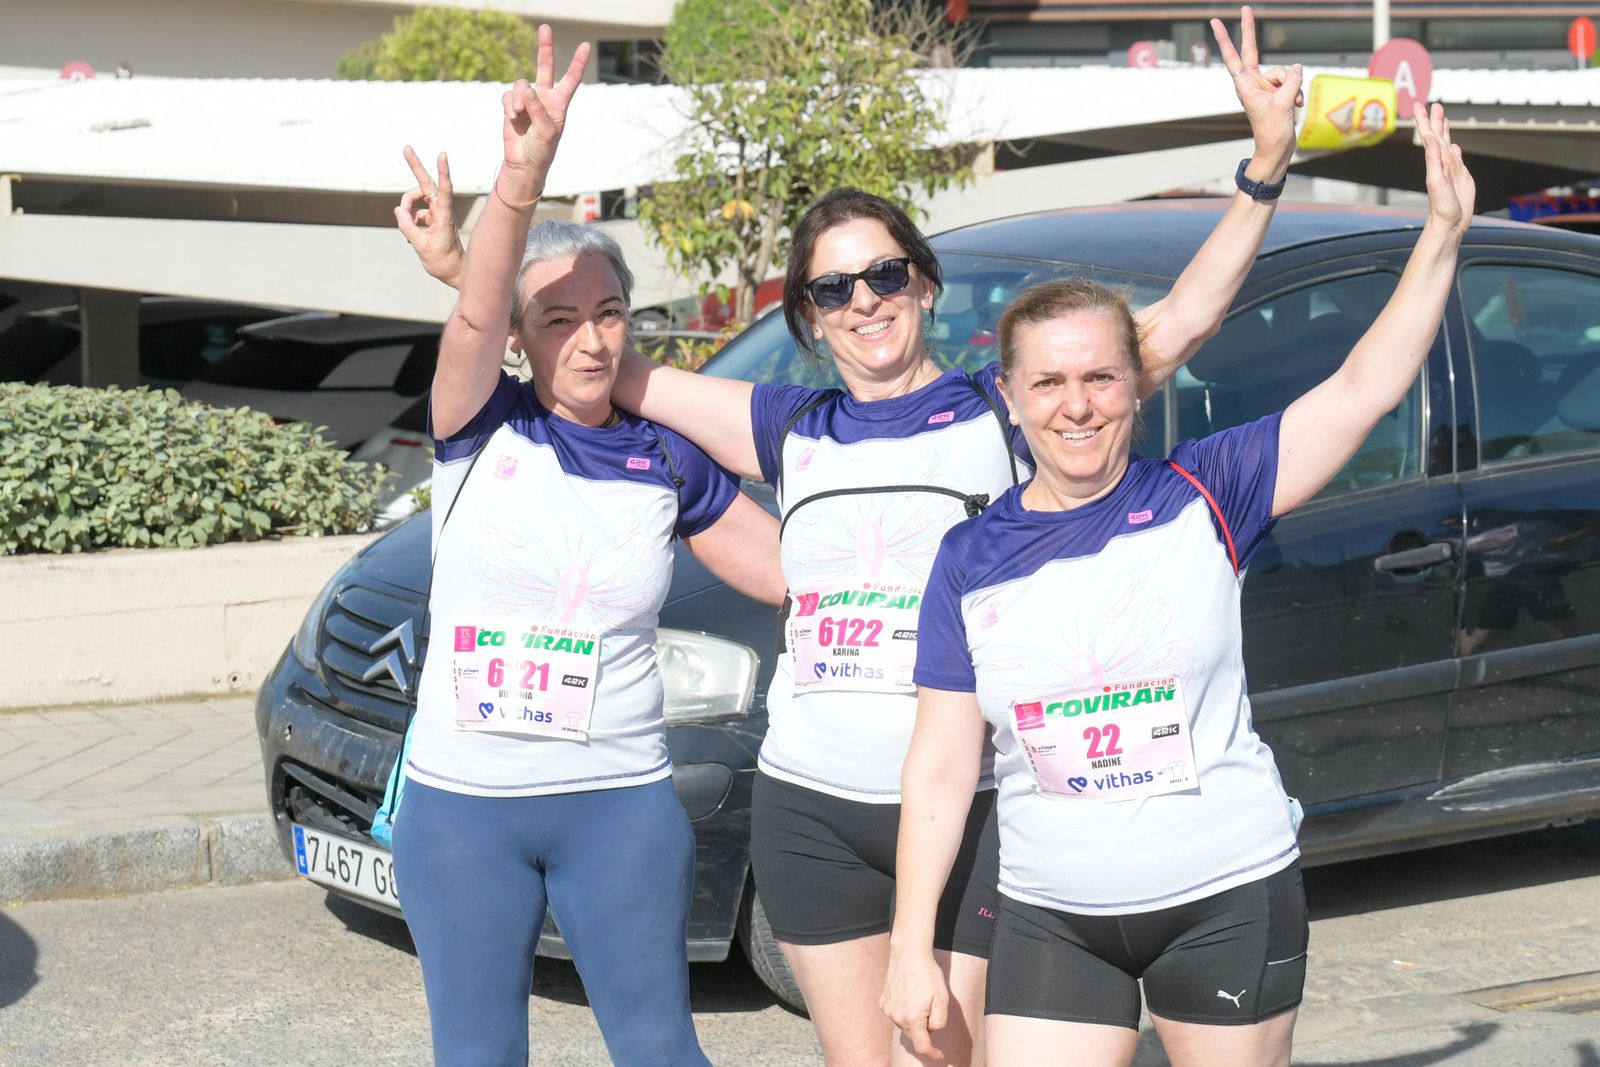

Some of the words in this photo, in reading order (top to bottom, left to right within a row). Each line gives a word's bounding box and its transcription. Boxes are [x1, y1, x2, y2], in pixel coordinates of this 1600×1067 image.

[1136, 49, 1151, 68] C
[1393, 59, 1417, 97] A
[541, 625, 597, 640] Fundación
[818, 616, 884, 647] 6122
[895, 631, 918, 639] 42K
[476, 629, 595, 655] COIRAN
[832, 648, 860, 657] KARINA
[487, 658, 550, 692] 621
[830, 663, 884, 679] vithas
[564, 676, 586, 686] 42K
[1114, 677, 1175, 691] Fundación
[499, 706, 553, 724] vthas
[1153, 725, 1178, 738] 42K
[1083, 723, 1123, 760] 22
[1091, 756, 1122, 770] NADINE
[1093, 770, 1154, 790] vithas
[299, 855, 306, 867] E
[307, 836, 363, 887] 7467
